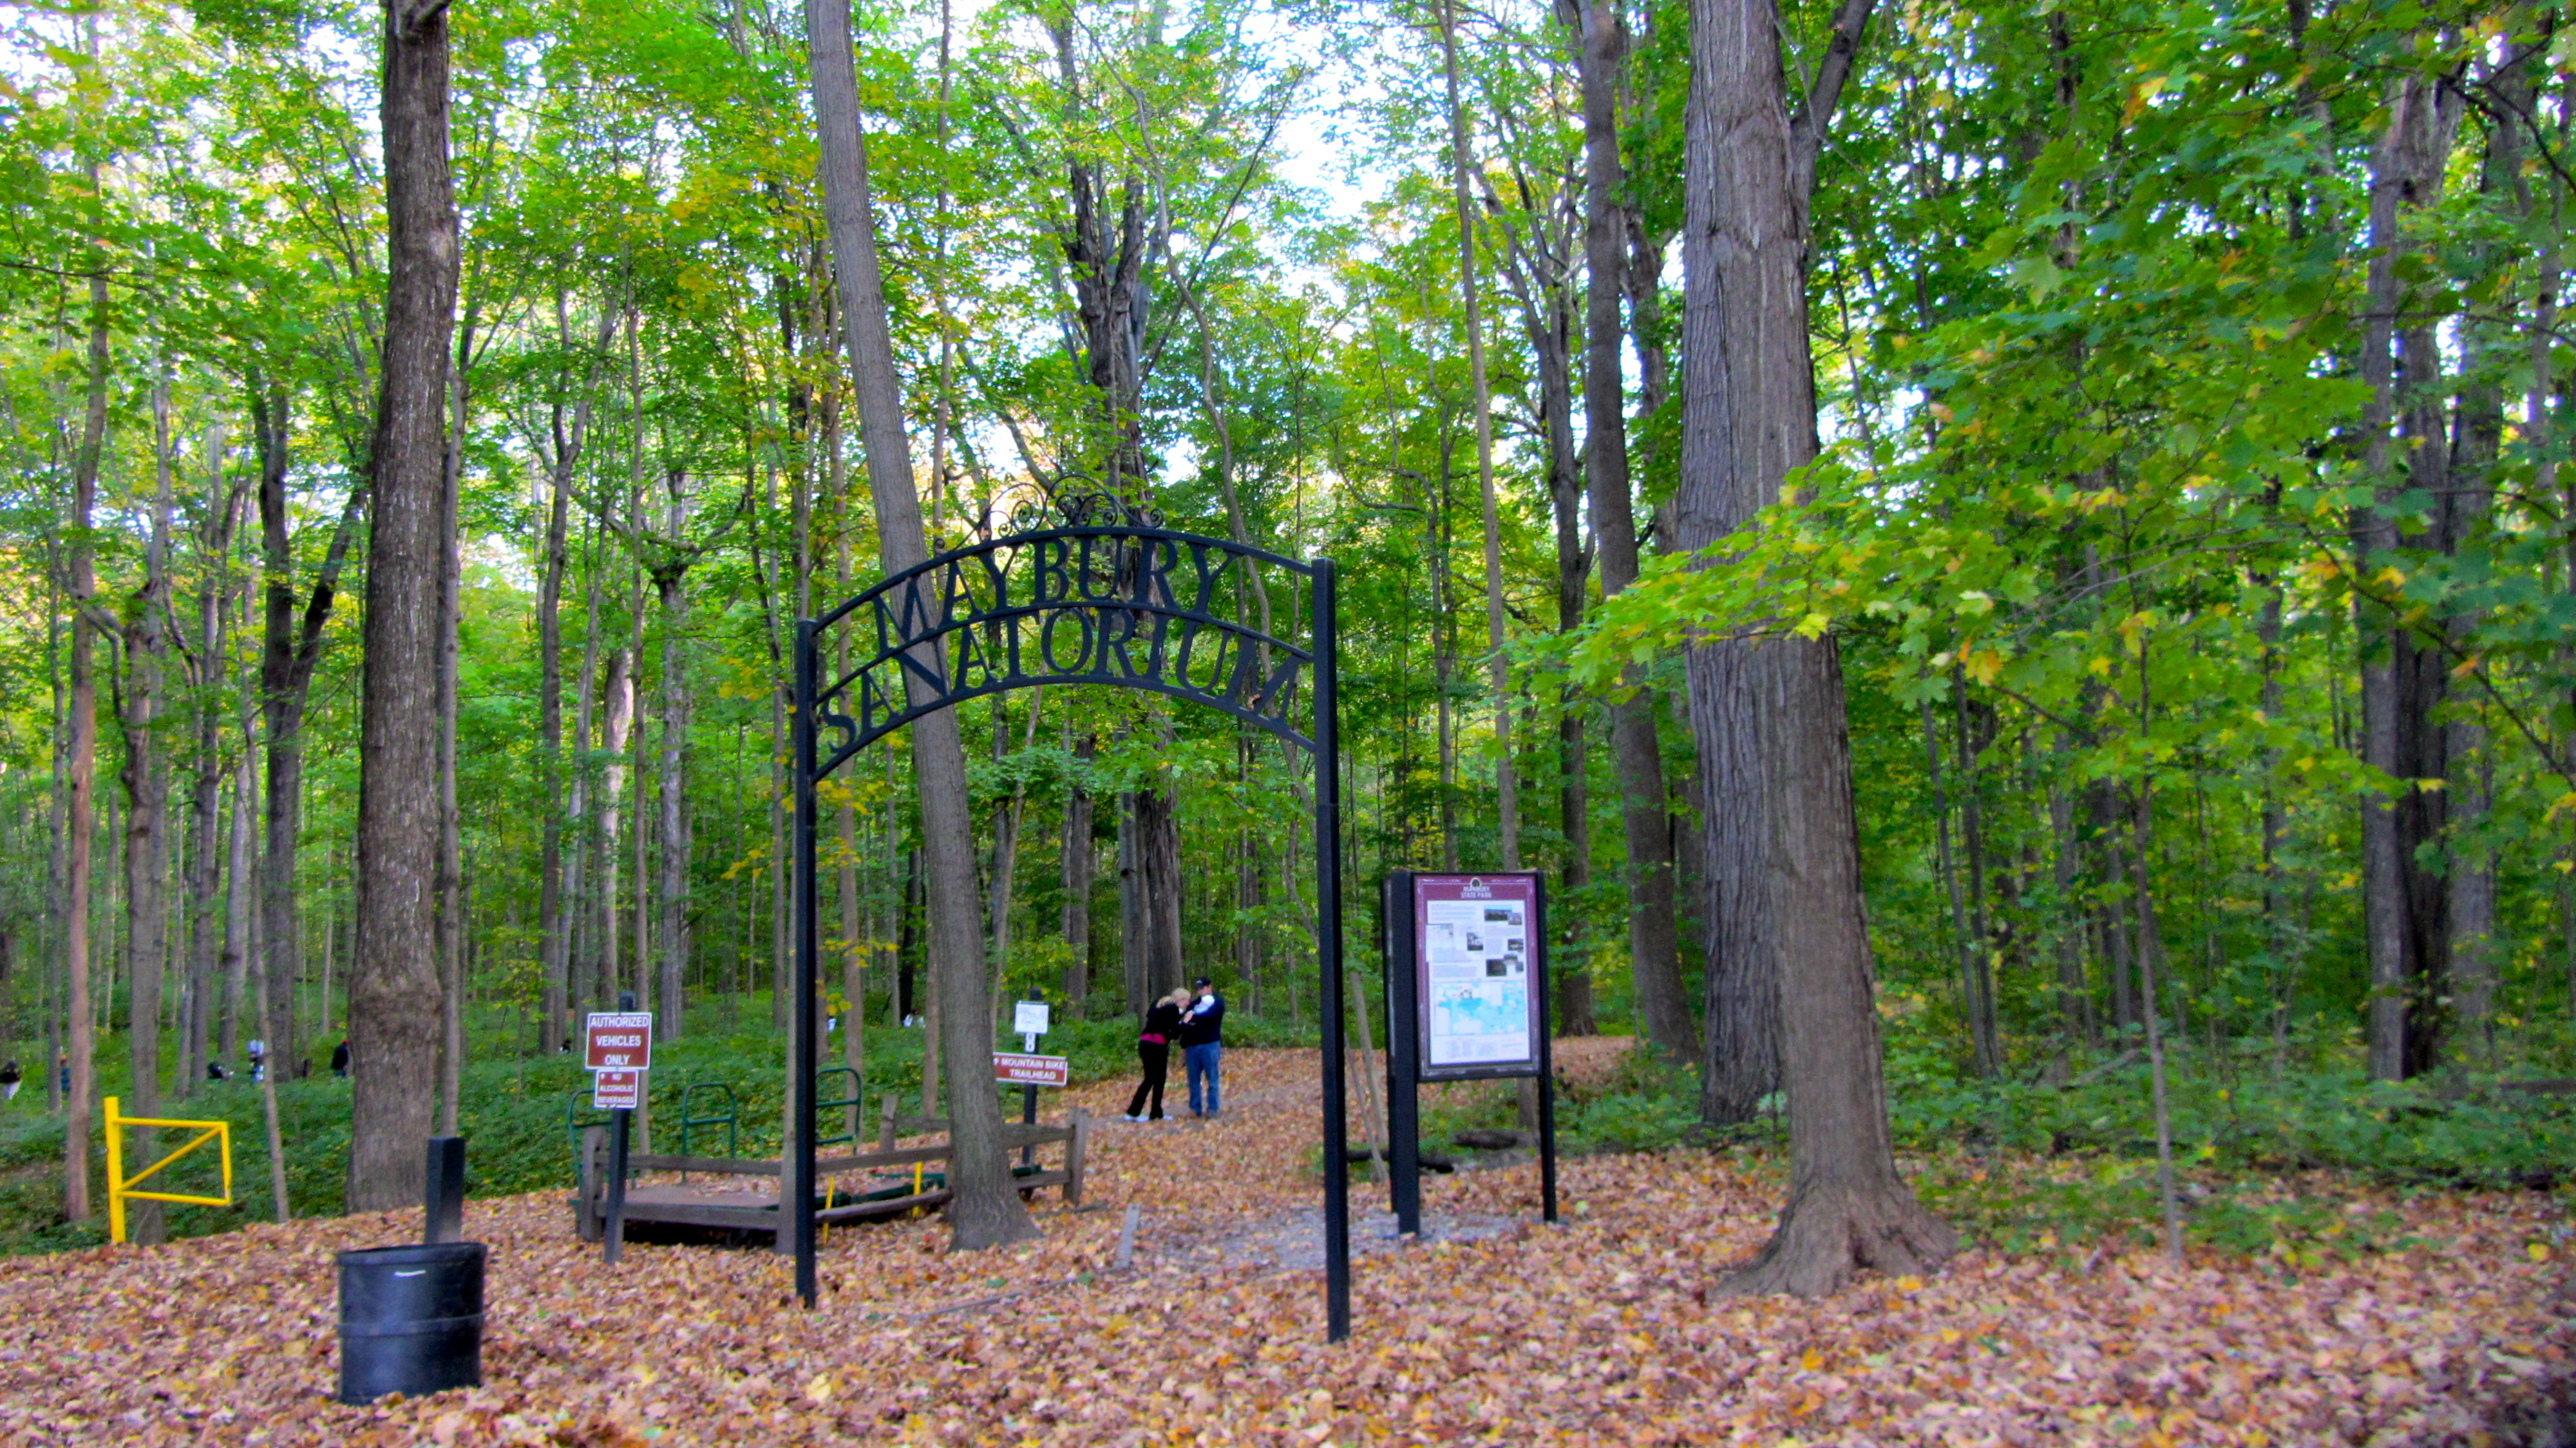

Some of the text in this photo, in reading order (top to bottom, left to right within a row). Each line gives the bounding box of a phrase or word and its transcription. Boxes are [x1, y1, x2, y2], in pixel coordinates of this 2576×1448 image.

[871, 535, 1244, 652] MAYBURY
[821, 607, 1305, 756] SANATORIUM
[590, 1016, 649, 1027] AUTHORIZED
[596, 1035, 641, 1047] VEHICLES
[604, 1054, 630, 1065] ONLY
[1001, 1058, 1065, 1069] MOUNTAIN BIKE
[612, 1073, 622, 1081] NO
[1009, 1069, 1057, 1080] TRAILHEAD
